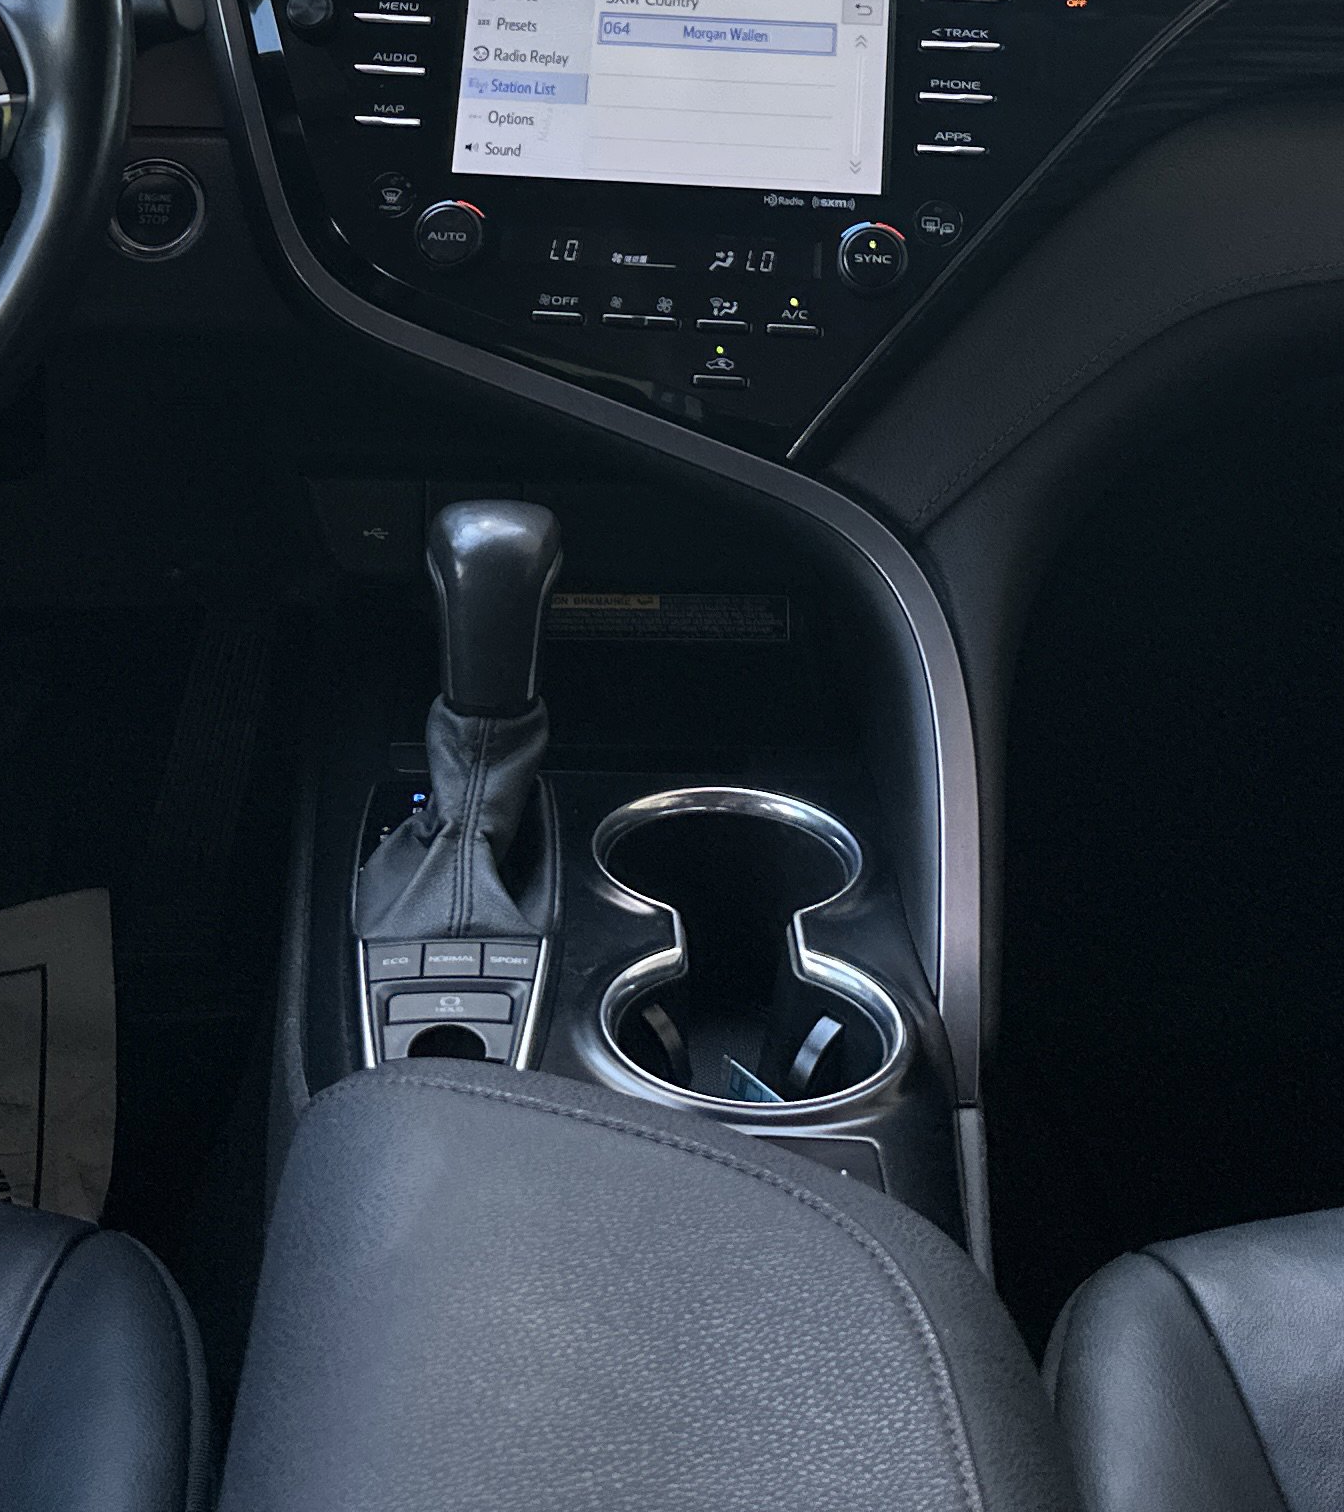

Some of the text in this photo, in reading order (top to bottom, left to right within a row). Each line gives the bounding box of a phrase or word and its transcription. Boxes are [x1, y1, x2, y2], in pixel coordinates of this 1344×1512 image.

[378, 1, 420, 12] MENU
[1066, 0, 1088, 7] OFF
[496, 17, 537, 33] Presets
[603, 20, 630, 35] 064
[683, 25, 727, 43] Morgan
[944, 28, 989, 39] TRACK
[372, 52, 418, 63] AUDIO
[494, 48, 569, 67] Radio Replay
[491, 78, 556, 96] Station List
[930, 79, 981, 90] PHONE
[373, 103, 405, 113] MAP
[488, 110, 535, 127] Options
[934, 131, 972, 142] APPS
[485, 141, 522, 157] Sound
[137, 203, 171, 213] START
[138, 215, 169, 225] STOP
[427, 231, 467, 242] AUTO
[550, 239, 580, 261] LO
[745, 250, 774, 273] LO
[854, 253, 893, 265] SYNC
[551, 296, 579, 306] OFF
[782, 309, 809, 320] A/C
[413, 793, 426, 802] P
[382, 957, 409, 966] ECO
[428, 955, 476, 963] NORMAL
[490, 955, 529, 965] SPORT
